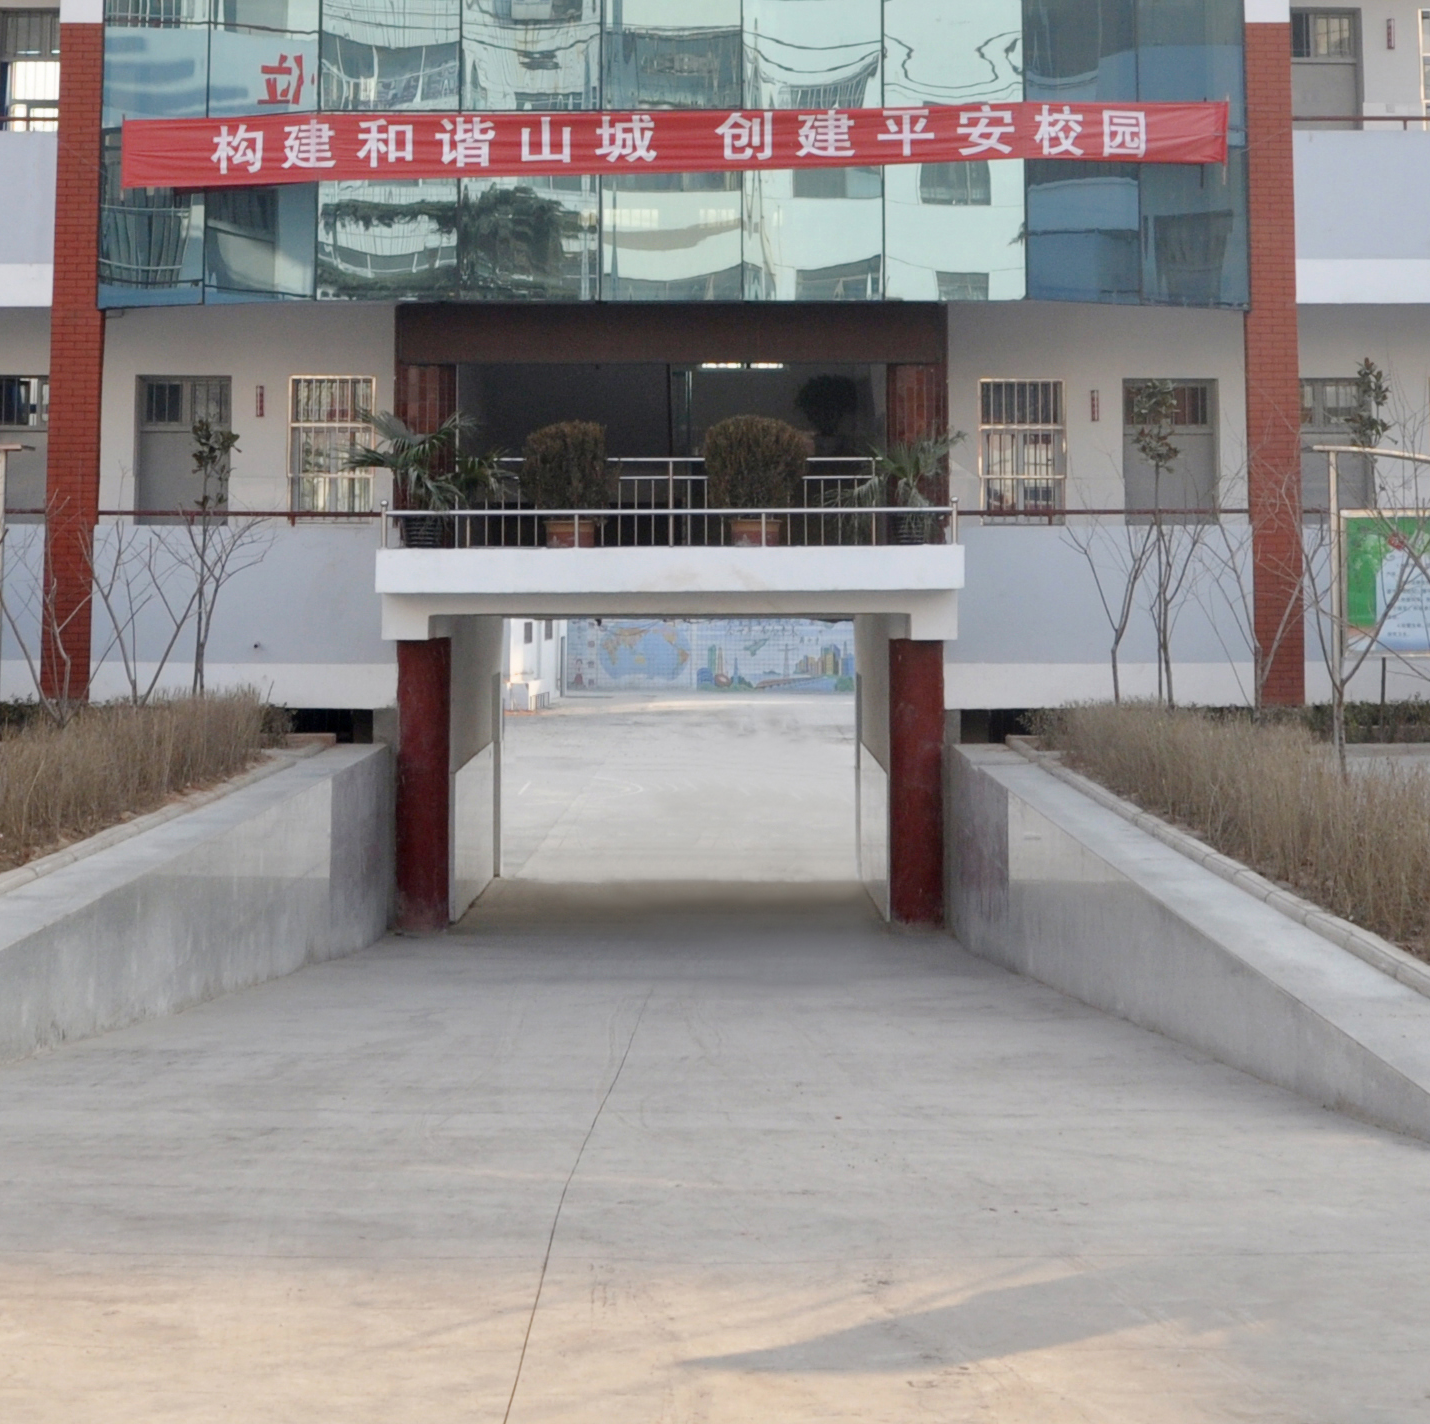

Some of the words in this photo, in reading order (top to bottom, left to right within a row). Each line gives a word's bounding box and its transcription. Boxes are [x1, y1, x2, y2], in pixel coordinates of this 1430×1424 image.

[212, 111, 658, 174] 构建和谐山城
[715, 102, 1150, 162] 创建平安校园
